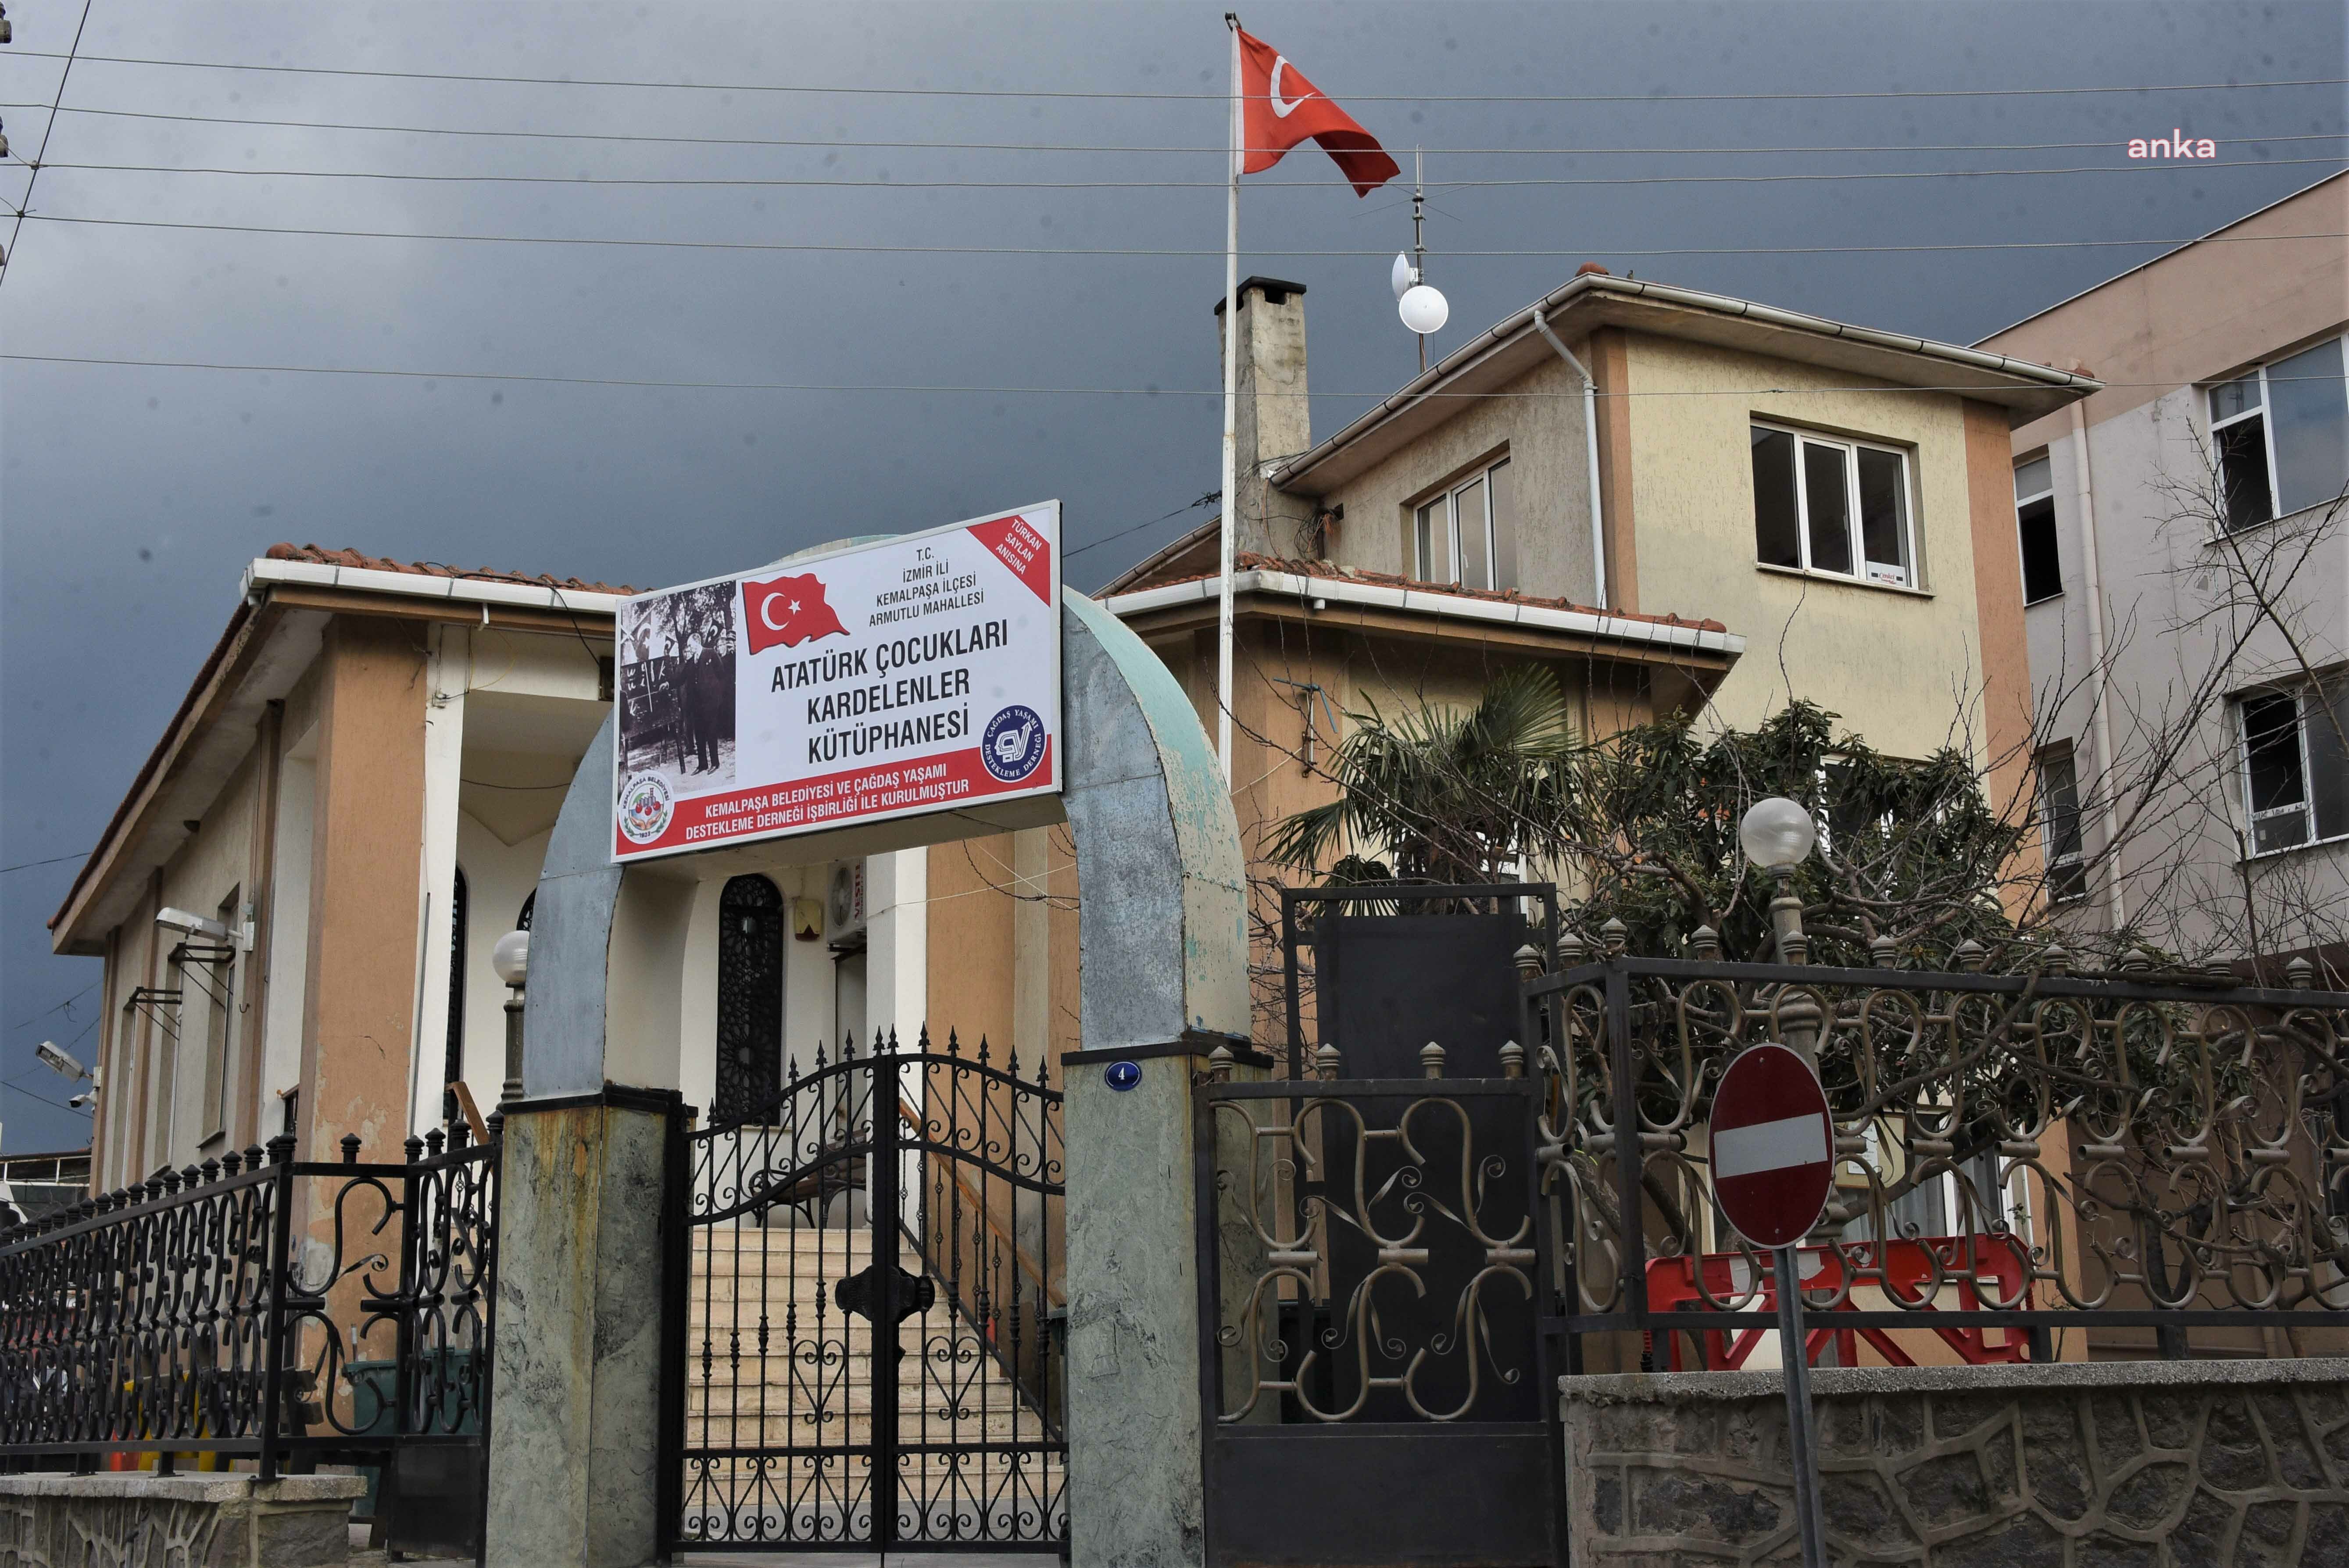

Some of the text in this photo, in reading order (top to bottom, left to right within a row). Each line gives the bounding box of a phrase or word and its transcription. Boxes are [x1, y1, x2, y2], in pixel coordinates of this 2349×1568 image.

[1005, 532, 1034, 562] SAYLAN
[1012, 519, 1042, 550] TÜRKAN
[903, 558, 948, 583] İZMİR İLİ
[916, 547, 934, 561] T.C.
[996, 543, 1026, 575] ANISINA
[876, 571, 976, 607] KEMALPAŞA İLÇESİ
[869, 588, 984, 627] ARMUTLU MAHALLESİ
[771, 619, 1008, 693] ATATÜRK ÇOCUKLARI
[807, 668, 970, 725] KARDELENLER
[808, 702, 969, 764] KÜTÜPHANESİ
[987, 709, 1039, 738] ÇAĞDAŞ YAŞAMI
[985, 744, 1021, 777] DESTEKLEME
[706, 763, 947, 818] KEMALPAŞA BELEDİYESİ VE ÇAĞDAŞ YAŞAMI
[686, 779, 969, 840] DESTEKLEME DERNEĞİ İŞBİRLİĞİ İLE KURULMUŞTUR
[1118, 1067, 1125, 1080] 4
